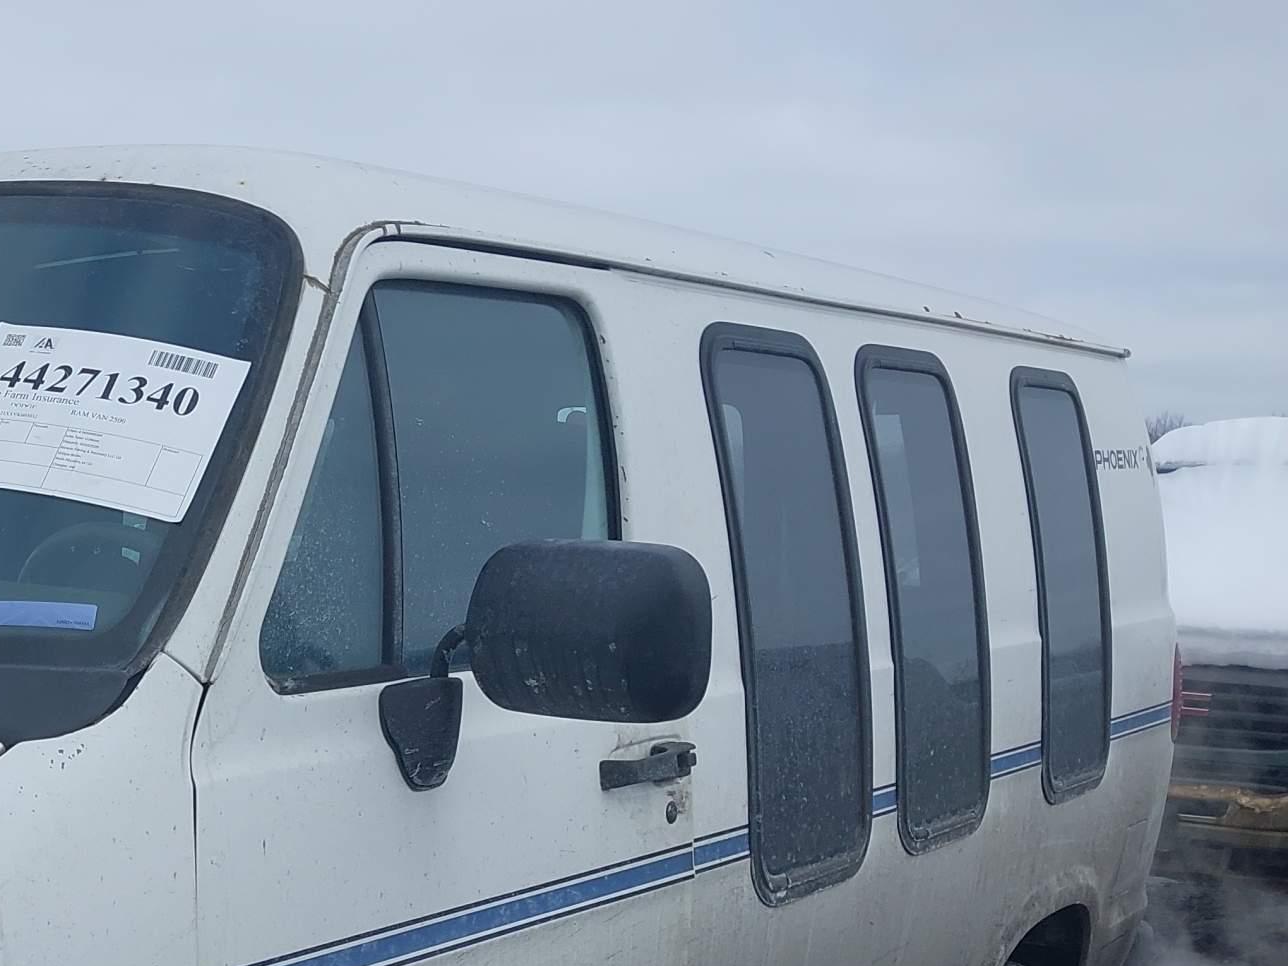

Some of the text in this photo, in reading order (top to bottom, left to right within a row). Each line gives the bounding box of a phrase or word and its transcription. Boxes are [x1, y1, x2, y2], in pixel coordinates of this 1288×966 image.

[0, 360, 200, 417] 44271340
[3, 390, 30, 401] Farm
[31, 392, 80, 406] Insurance
[70, 408, 89, 419] RAM
[91, 411, 108, 421] VAN
[1094, 448, 1139, 471] PHOENIX
